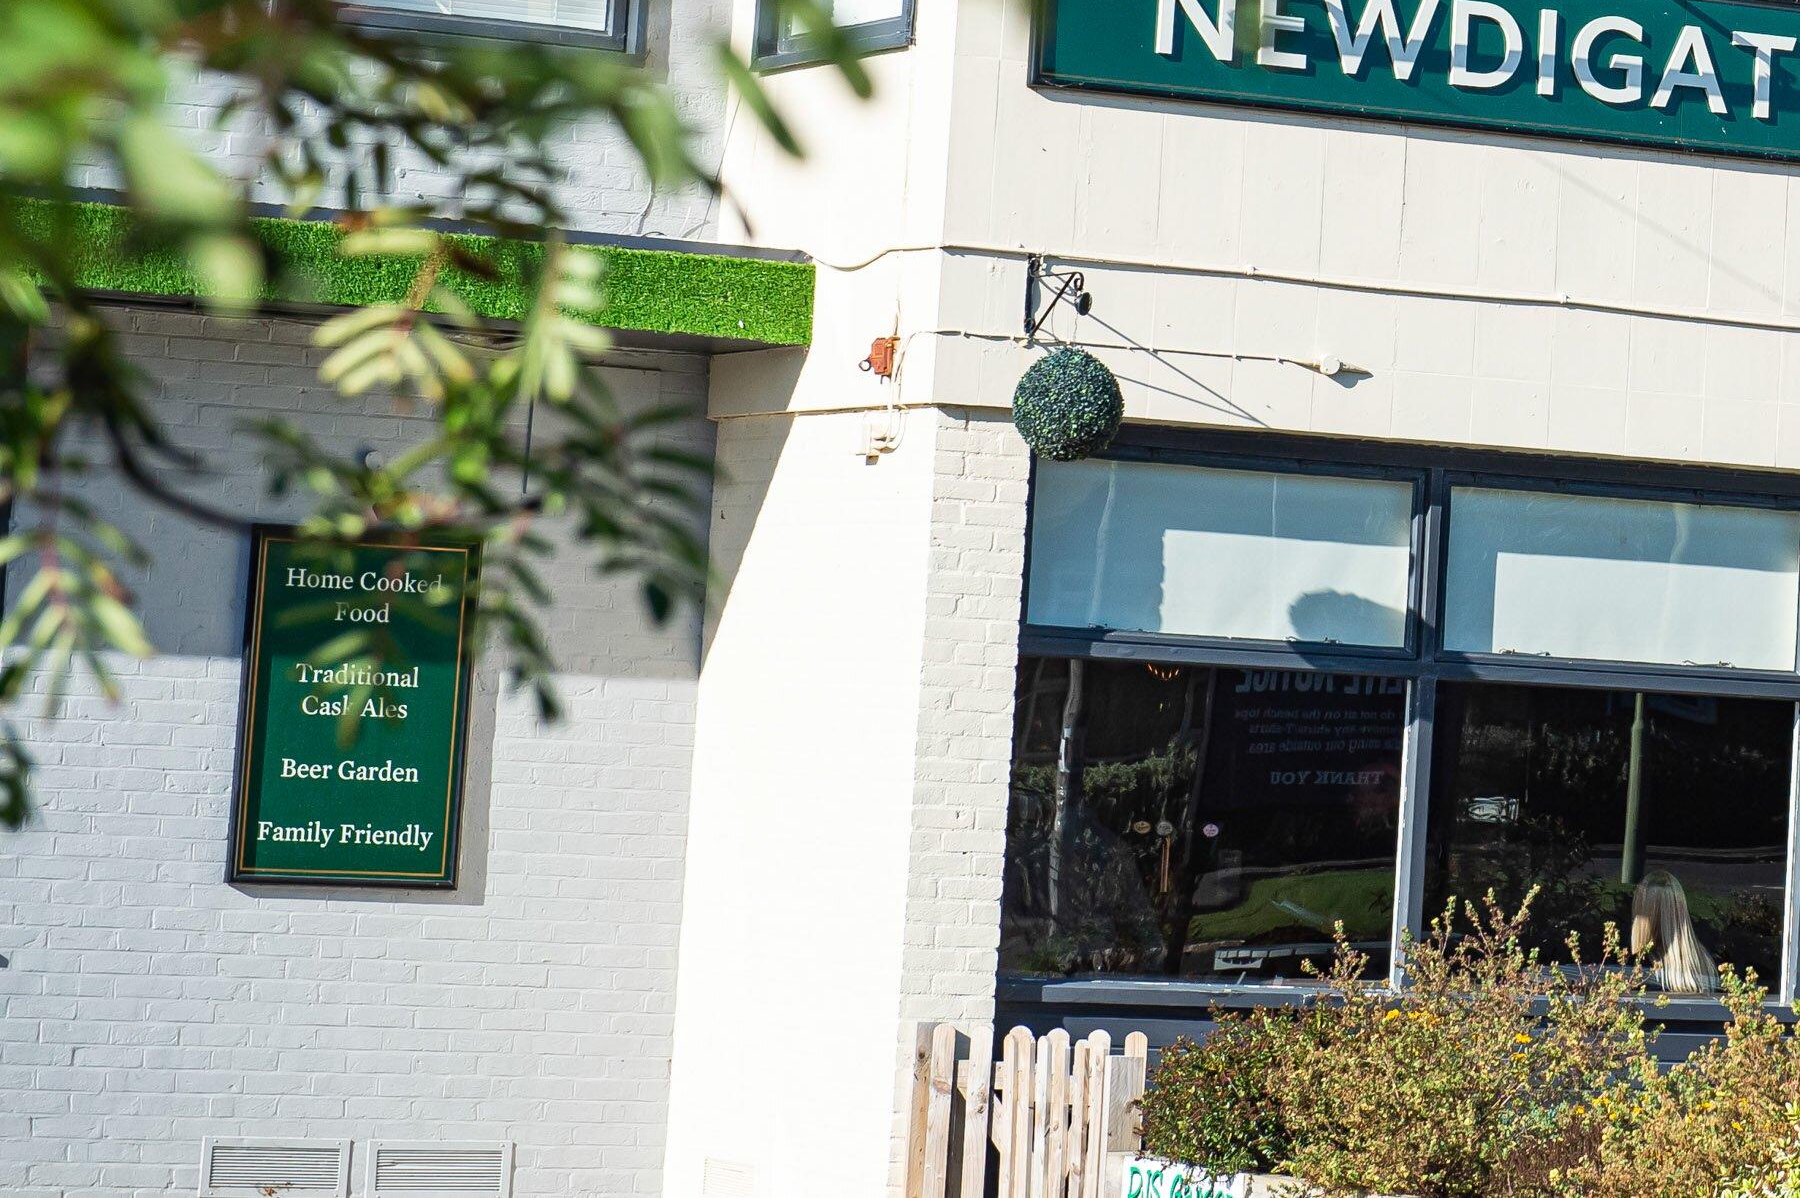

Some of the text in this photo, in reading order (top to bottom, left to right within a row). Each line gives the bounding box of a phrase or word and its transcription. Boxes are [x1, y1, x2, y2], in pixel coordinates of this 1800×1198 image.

[285, 567, 442, 594] Home Cooked
[334, 602, 390, 624] Food
[294, 662, 419, 689] Traditional
[360, 697, 408, 720] Ales
[280, 758, 419, 782] Beer Garden
[256, 820, 433, 851] Family Friendly
